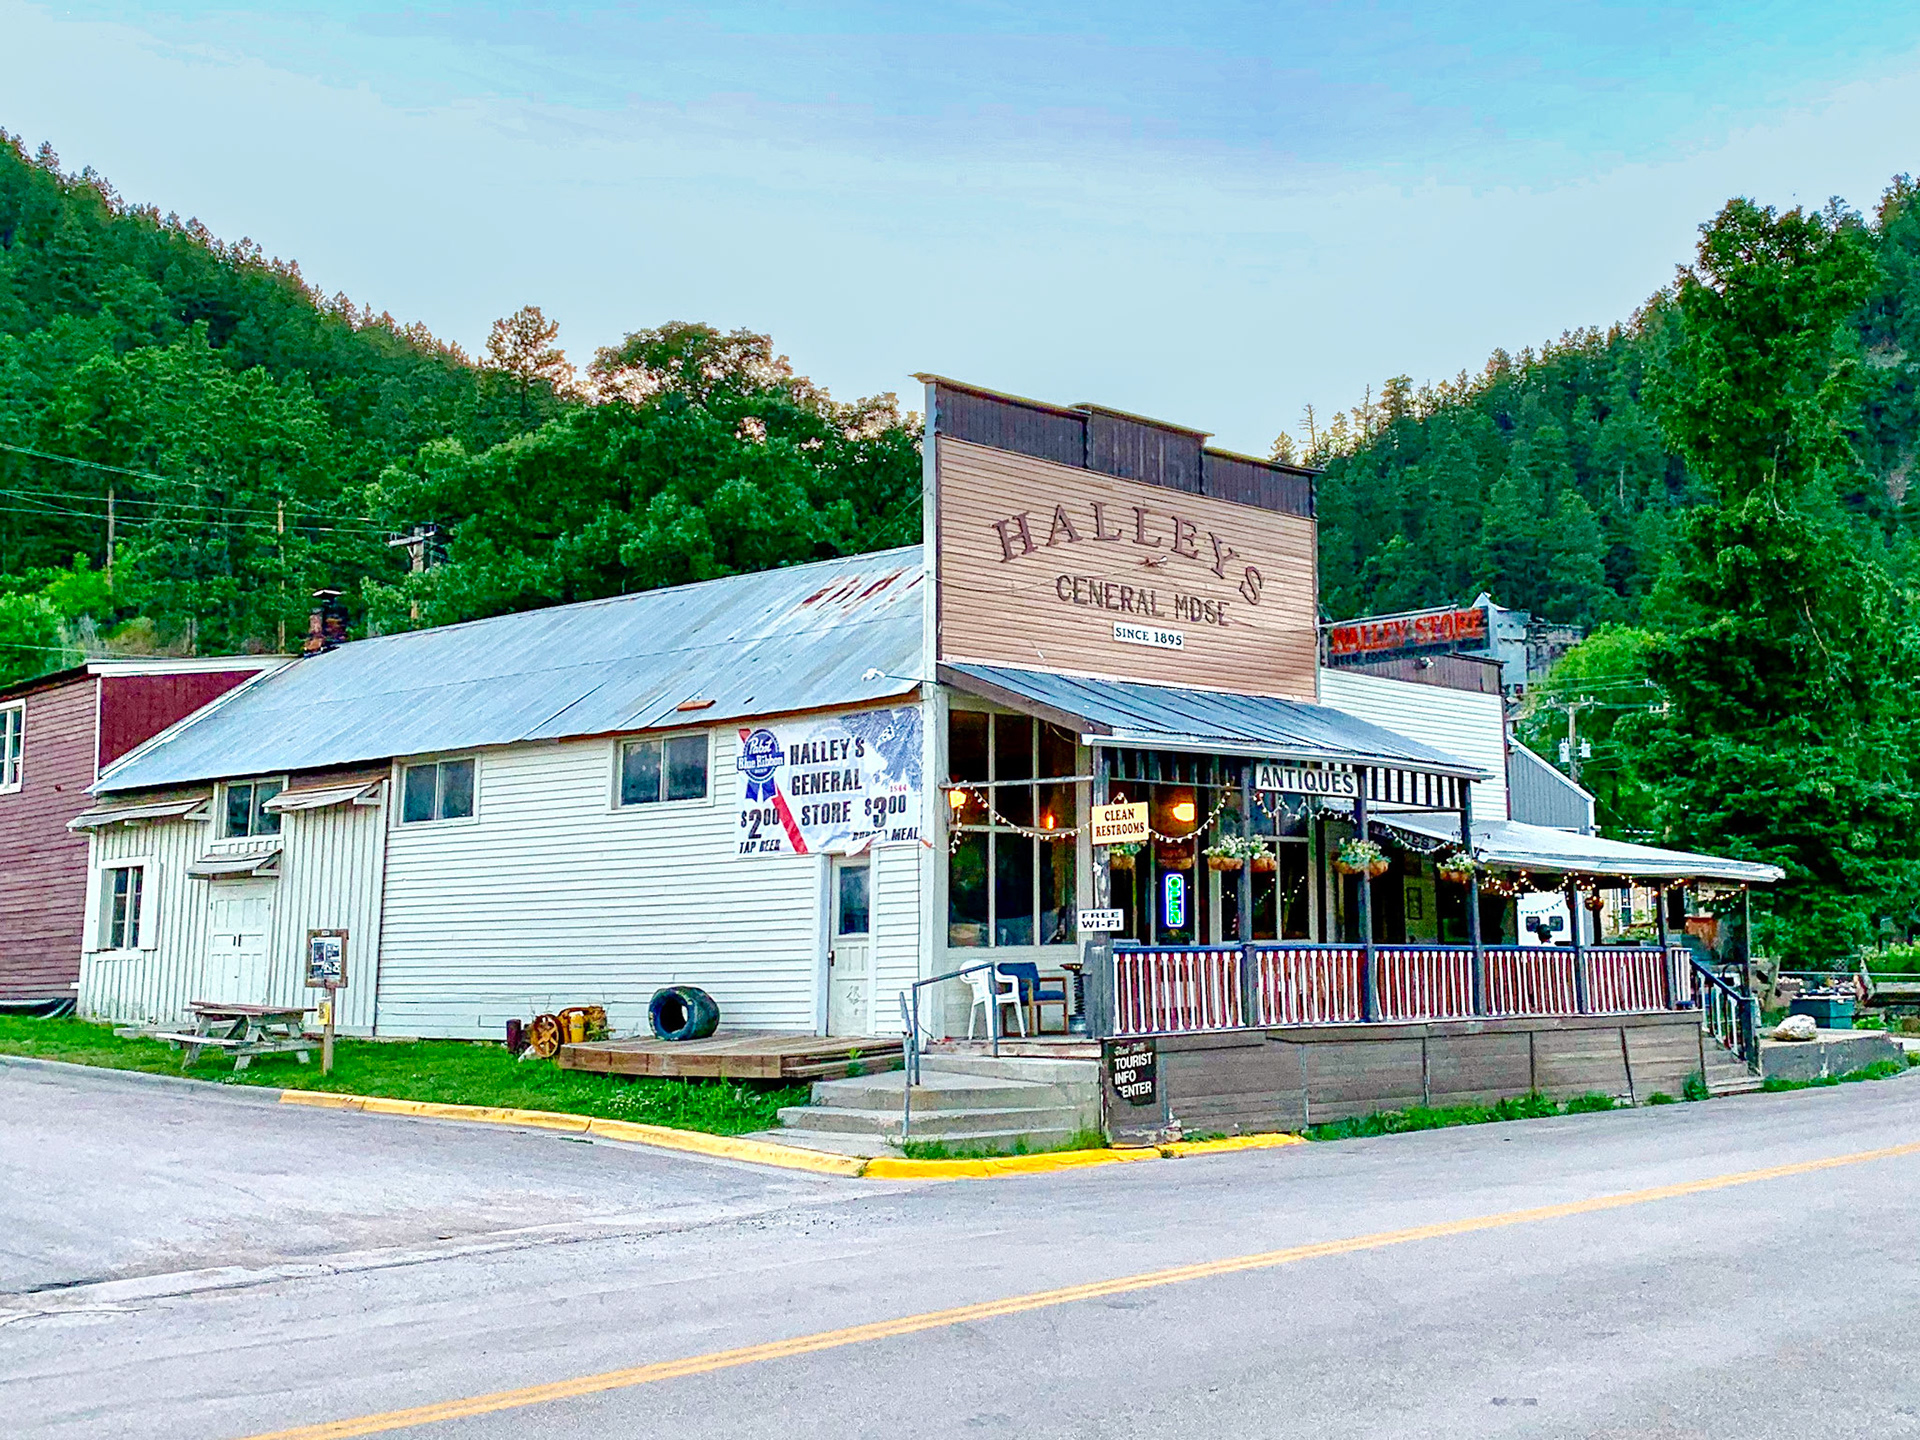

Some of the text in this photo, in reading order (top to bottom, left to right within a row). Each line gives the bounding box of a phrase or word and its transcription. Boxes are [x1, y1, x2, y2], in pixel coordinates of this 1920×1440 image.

[991, 502, 1264, 605] HALLEYS
[1174, 593, 1230, 627] MDSE
[1115, 626, 1183, 646] SINCE 1895
[790, 736, 865, 766] HALLEY'S
[791, 768, 863, 796] GENERAL
[1260, 765, 1354, 794] ANTIQUES
[801, 800, 852, 827] STORE
[1104, 807, 1135, 822] CLEAN
[891, 826, 919, 841] MEAL
[1095, 821, 1145, 838] RESTROOMS
[739, 838, 781, 854] TAP BEER
[1168, 876, 1182, 925] OPEN
[1081, 911, 1119, 920] FREE
[1081, 919, 1120, 929] WI-FI
[1114, 1052, 1153, 1070] TOURIST
[1114, 1070, 1137, 1085] INFO
